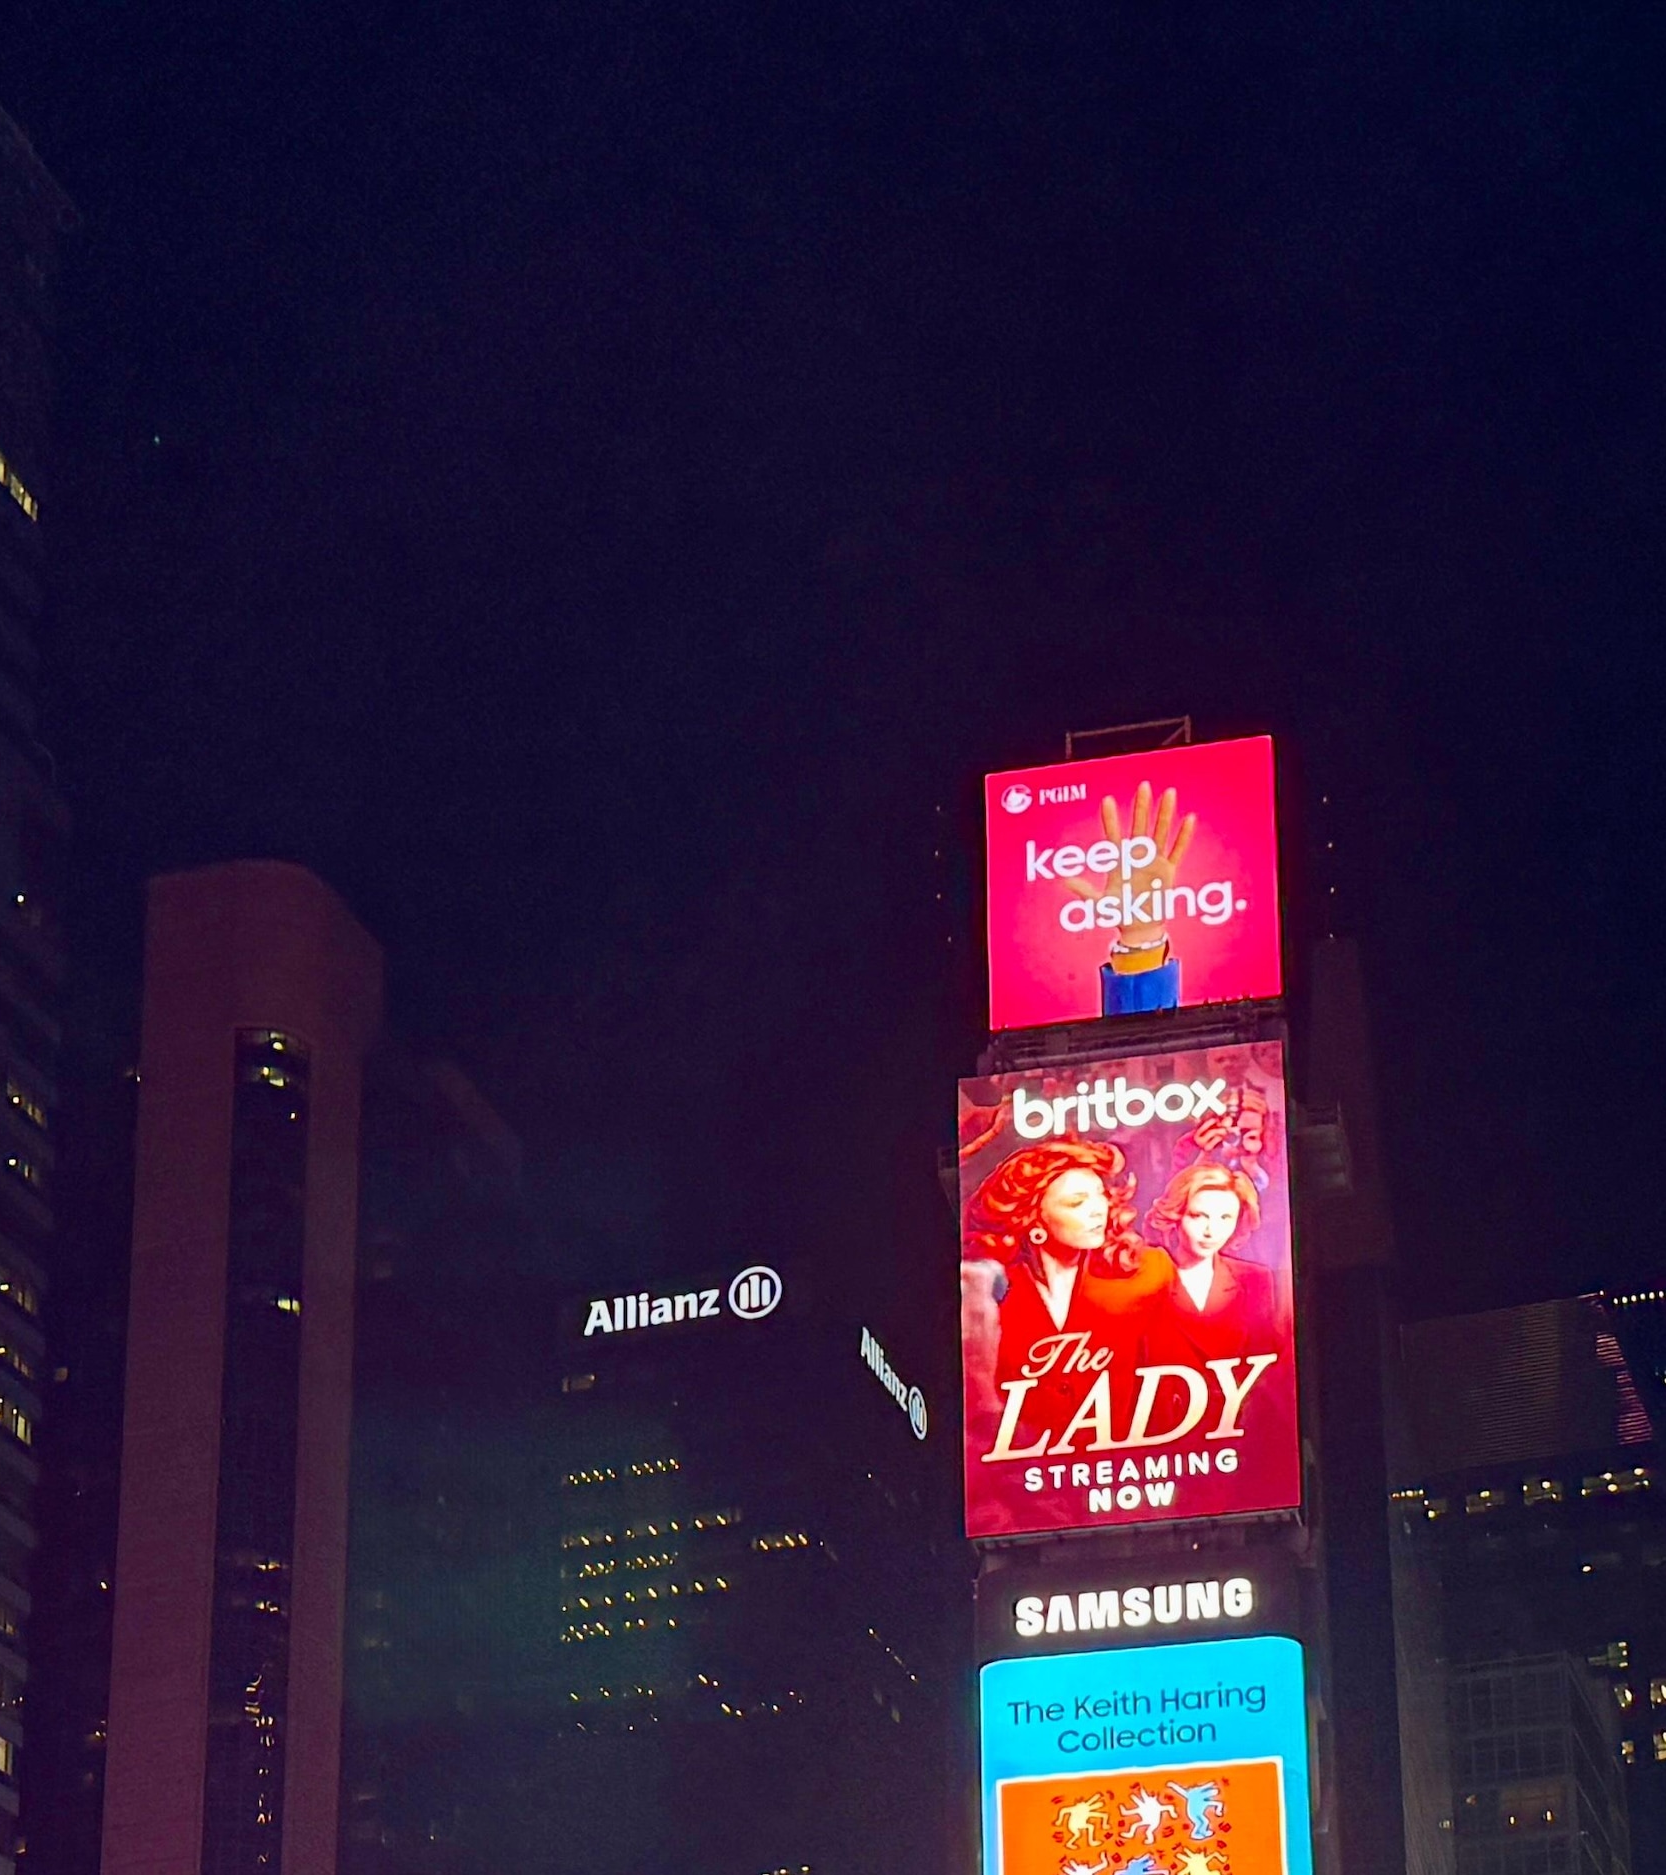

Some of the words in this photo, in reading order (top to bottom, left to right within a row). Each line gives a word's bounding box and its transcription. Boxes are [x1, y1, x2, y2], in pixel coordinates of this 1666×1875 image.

[1039, 783, 1087, 806] PGIM
[1026, 835, 1156, 883] keep
[1059, 872, 1247, 934] asking.
[1013, 1078, 1226, 1140] britbox
[584, 1289, 720, 1336] Allianz
[861, 1327, 908, 1412] Allianz
[1020, 1331, 1114, 1379] The
[981, 1354, 1277, 1463] LADY
[1025, 1449, 1239, 1493] STREAMING
[1088, 1482, 1176, 1513] NOW
[1015, 1578, 1253, 1637] SAMSUNG
[1008, 1699, 1065, 1726] The
[1074, 1690, 1151, 1721] Keith
[1161, 1683, 1267, 1714] Haring
[1058, 1720, 1216, 1754] Collection
